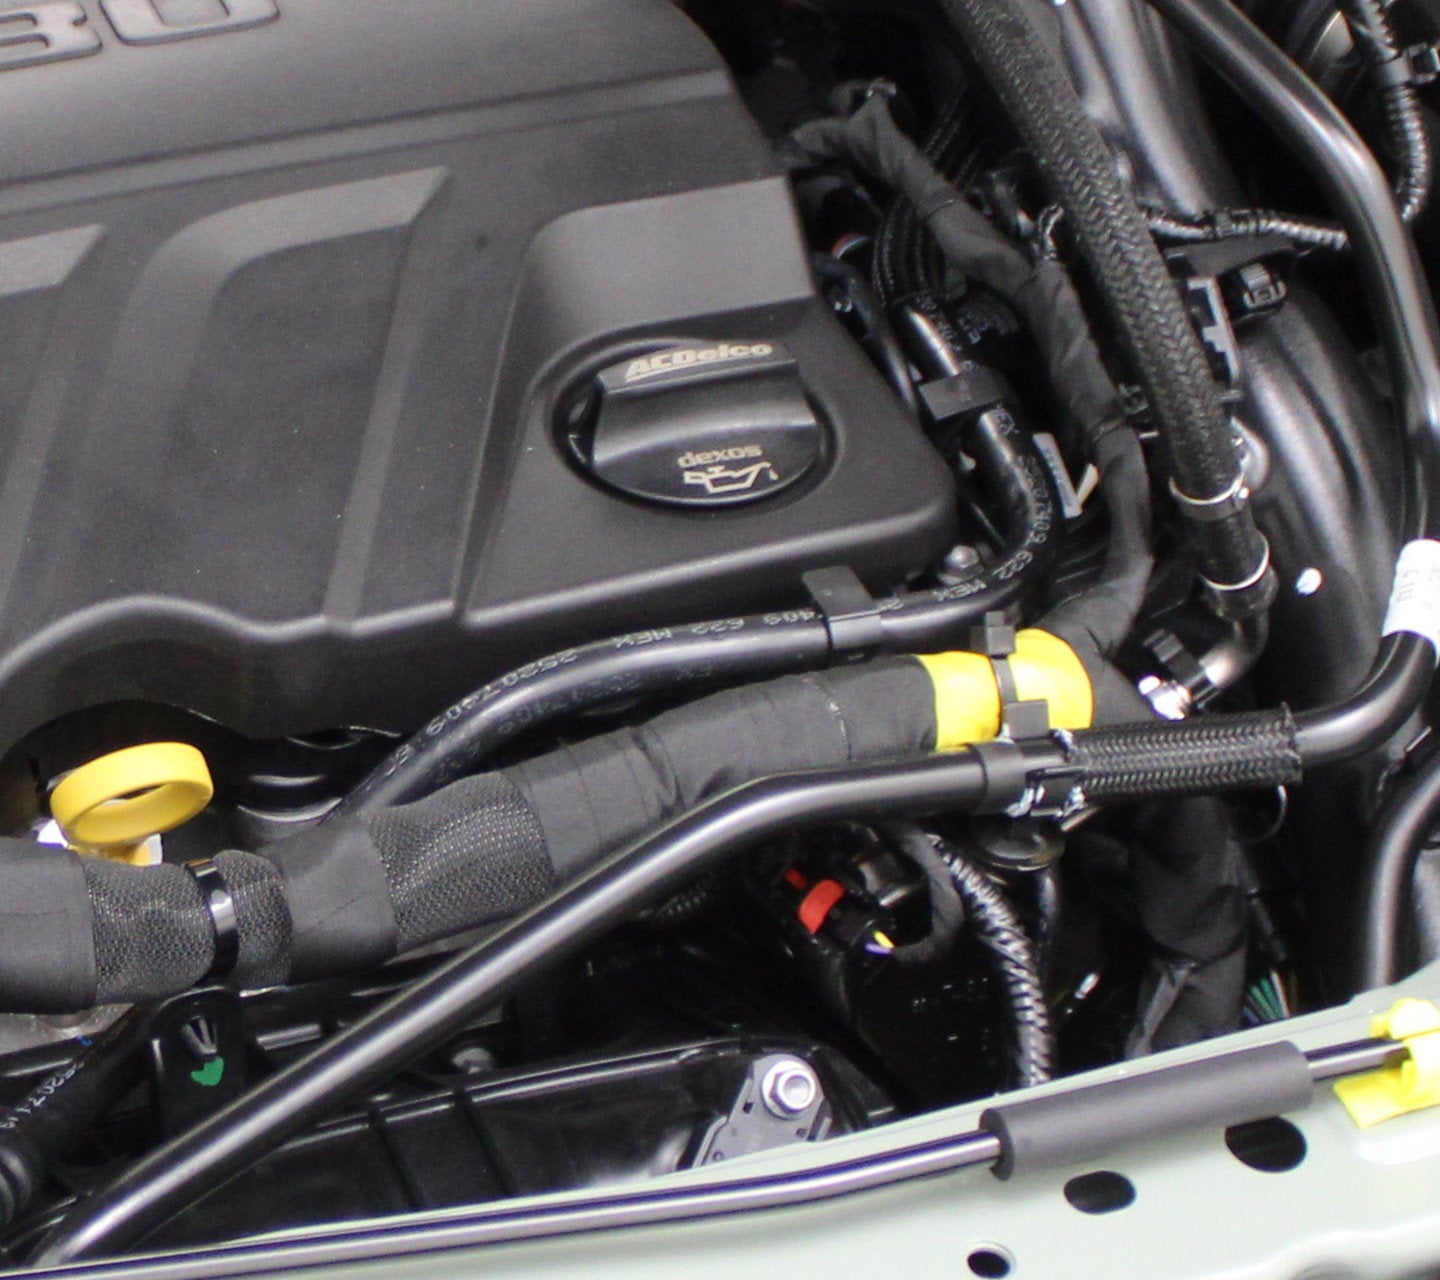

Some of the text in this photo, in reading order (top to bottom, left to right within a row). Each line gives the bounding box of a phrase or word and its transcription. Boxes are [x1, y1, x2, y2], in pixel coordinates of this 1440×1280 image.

[625, 343, 773, 378] ACDelco
[677, 444, 764, 468] dexos
[613, 627, 673, 649] MEX
